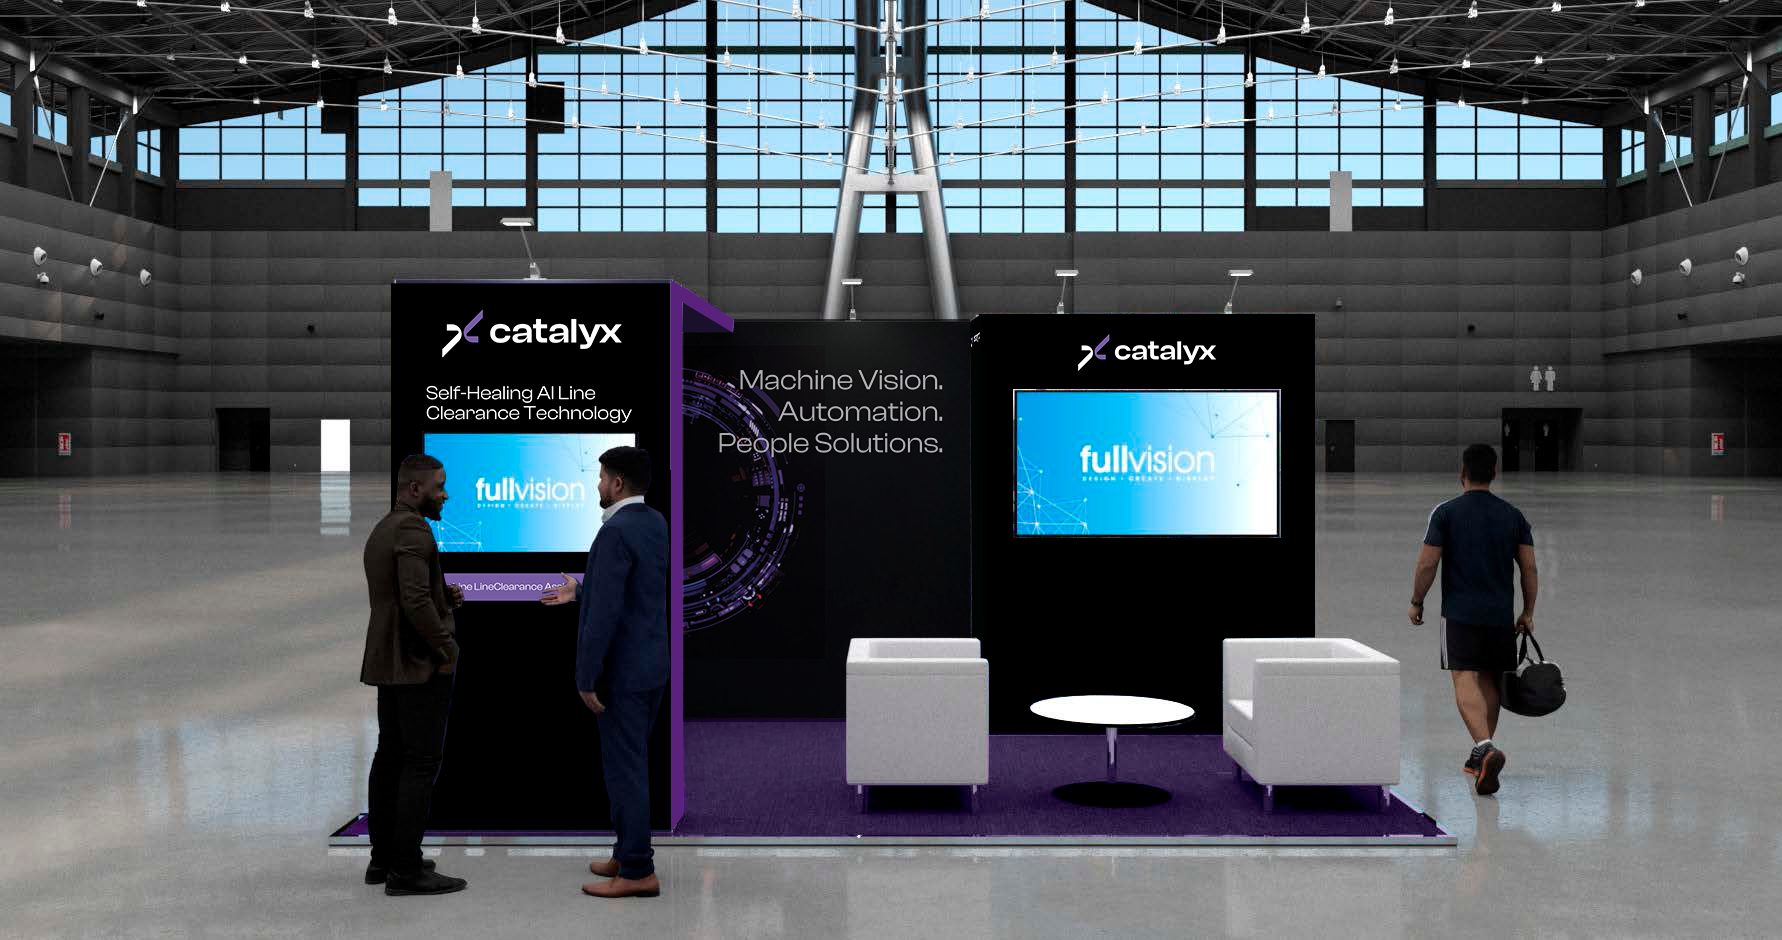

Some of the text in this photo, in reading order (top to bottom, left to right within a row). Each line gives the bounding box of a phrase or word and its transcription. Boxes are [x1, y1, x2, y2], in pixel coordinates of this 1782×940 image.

[489, 318, 622, 350] catalyx
[1114, 340, 1217, 365] catalyx
[739, 369, 944, 391] Machine Vision.
[425, 385, 597, 404] Self-Healing AI Line
[425, 405, 633, 424] Clearance Technology
[778, 401, 944, 422] Automation.
[718, 432, 944, 458] People Solutions.
[1080, 444, 1216, 474] fullvision
[475, 477, 586, 501] fullvision
[473, 582, 544, 592] LineClearance
